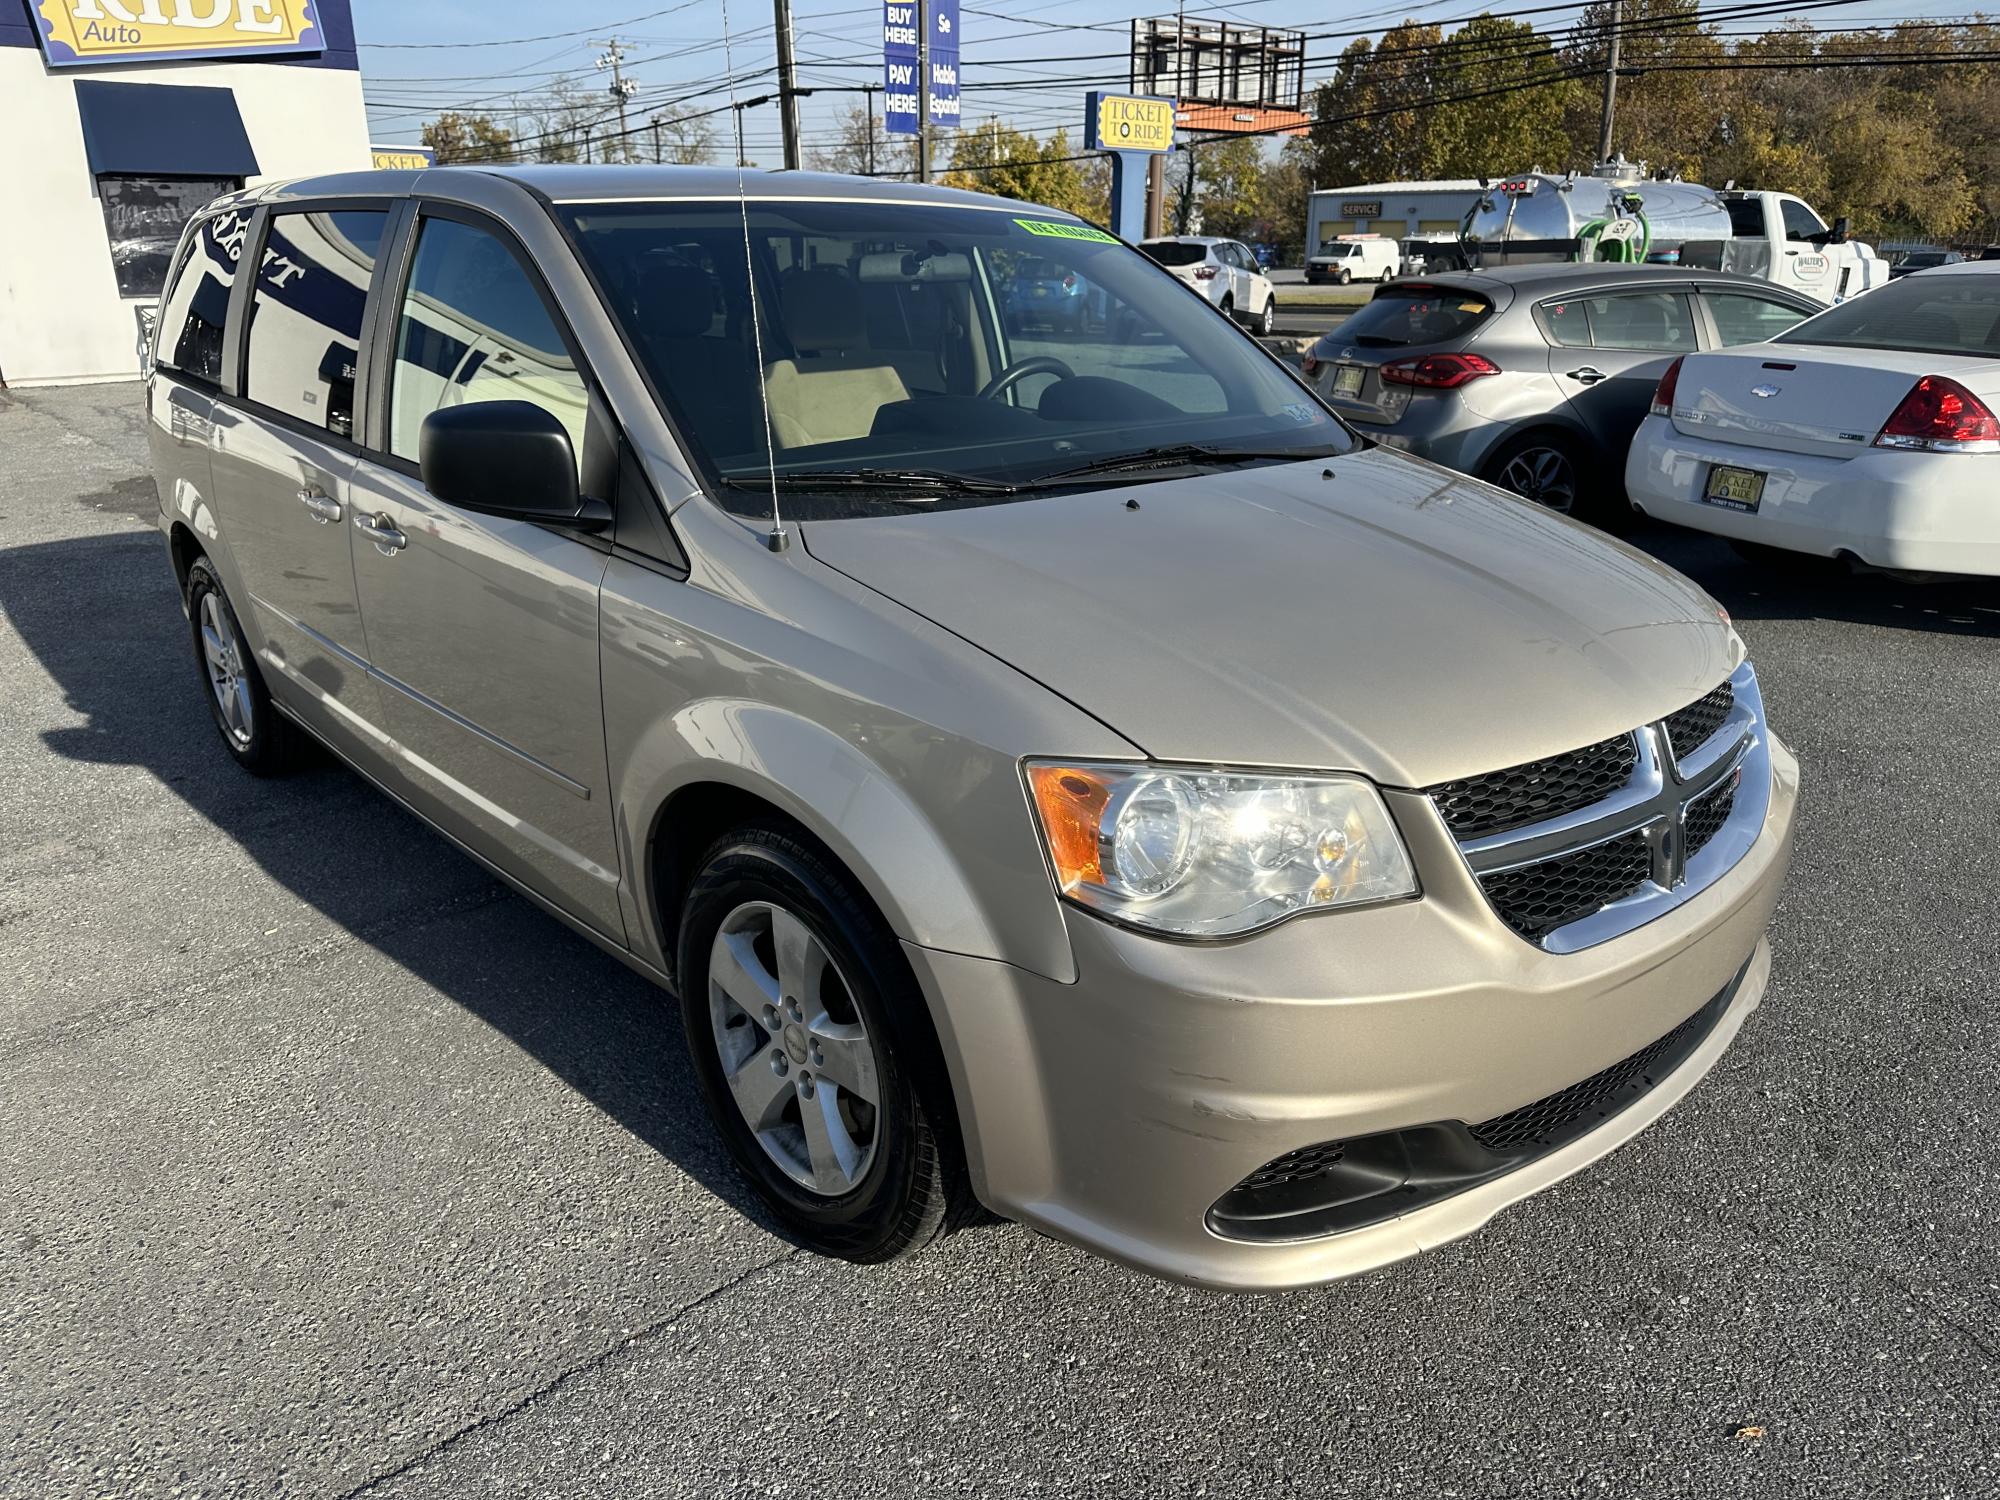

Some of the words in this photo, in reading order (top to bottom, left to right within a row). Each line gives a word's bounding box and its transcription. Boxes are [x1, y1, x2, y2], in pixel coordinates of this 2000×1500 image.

[888, 6, 912, 25] BUY
[938, 13, 951, 33] Se
[82, 20, 142, 44] Auto
[885, 26, 916, 45] HERE
[889, 64, 912, 85] PAY
[933, 64, 956, 85] Habla
[886, 93, 917, 114] HERE
[930, 93, 960, 119] Español
[1110, 101, 1165, 122] TICKET
[1134, 123, 1164, 140] RIDE
[372, 154, 417, 170] ICKET
[1343, 204, 1377, 215] SERVICE
[1048, 224, 1116, 242] FINANCE
[1717, 473, 1754, 490] TICKET
[1731, 487, 1753, 500] RIDE
